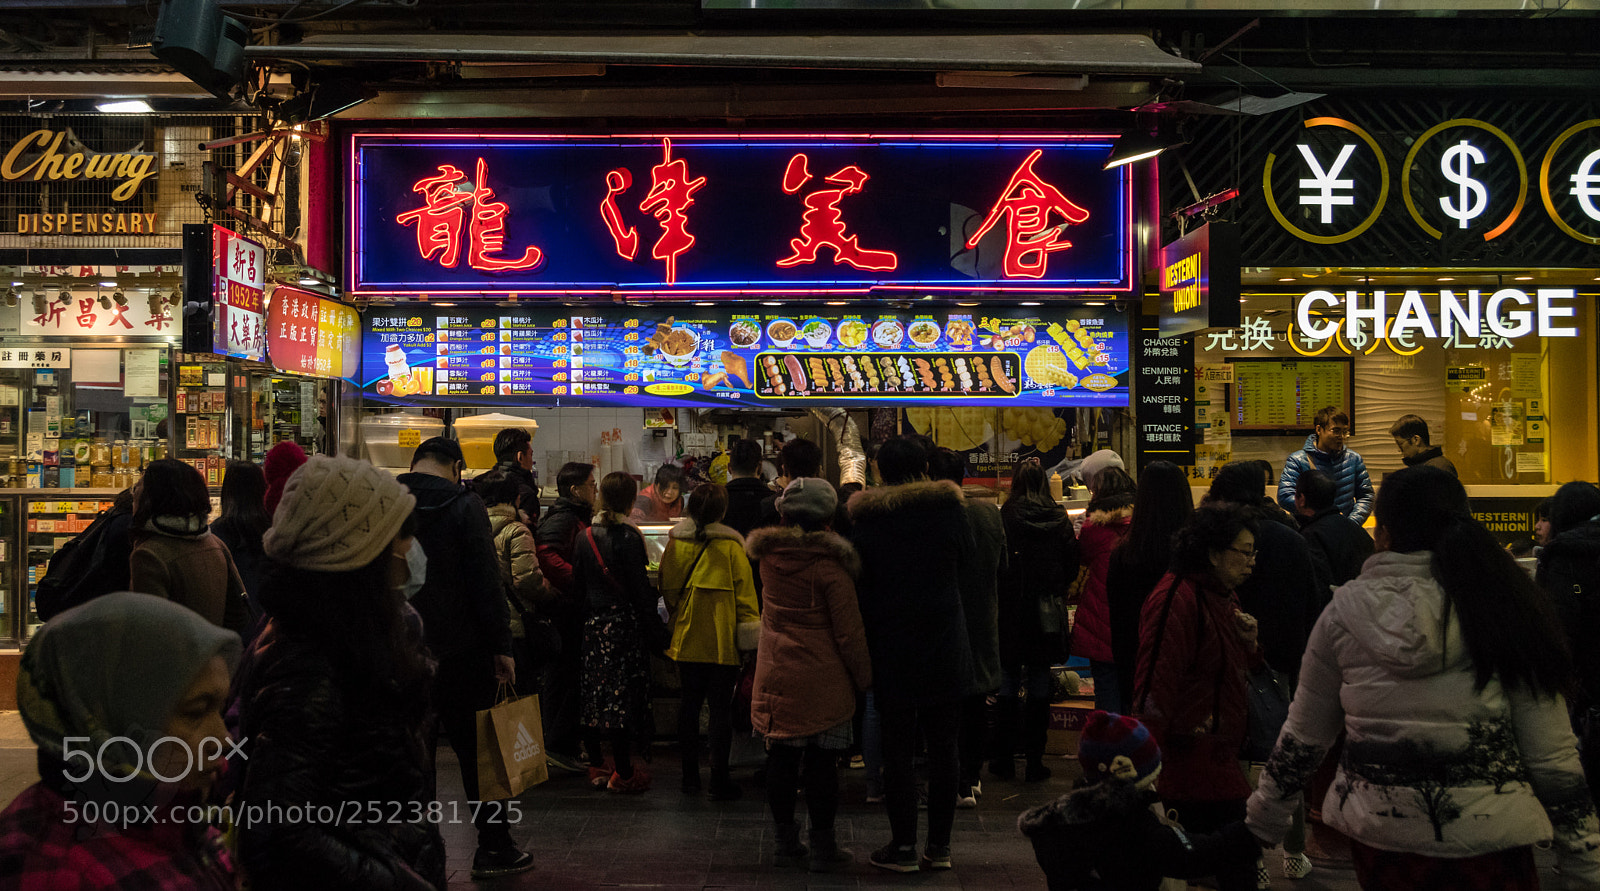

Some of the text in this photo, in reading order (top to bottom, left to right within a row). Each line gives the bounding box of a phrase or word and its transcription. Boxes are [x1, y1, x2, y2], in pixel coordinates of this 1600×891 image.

[0, 129, 157, 201] Cheung
[18, 213, 158, 235] DISPENSARY
[1165, 253, 1198, 289] WESTERN
[230, 284, 259, 312] 1952年
[1173, 284, 1198, 314] UNION
[1297, 288, 1578, 340] CHANGE
[1005, 338, 1020, 347] $10
[1143, 338, 1181, 347] CHANGE
[1154, 376, 1181, 385] 人民幣
[1485, 522, 1526, 532] UNION
[513, 743, 541, 763] adidas
